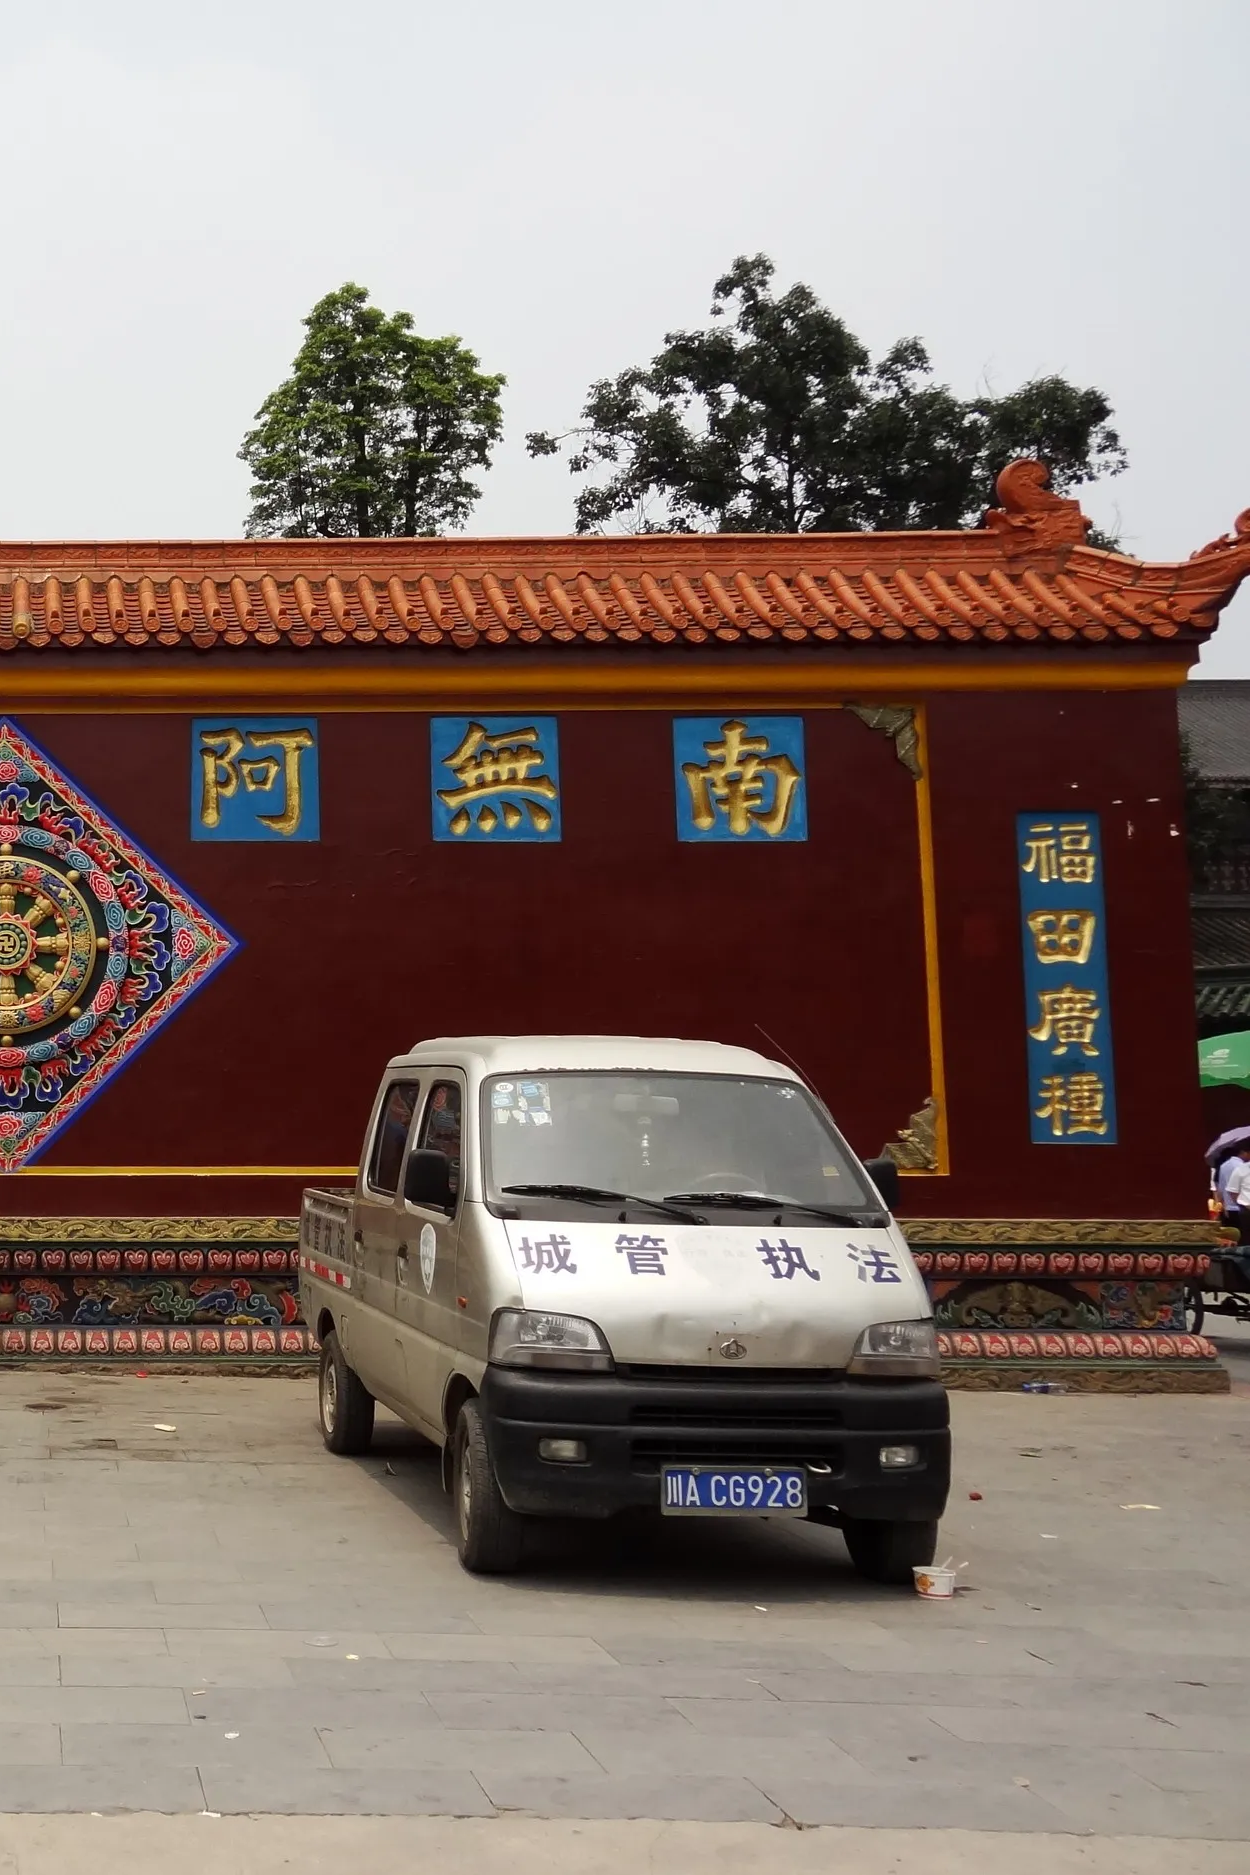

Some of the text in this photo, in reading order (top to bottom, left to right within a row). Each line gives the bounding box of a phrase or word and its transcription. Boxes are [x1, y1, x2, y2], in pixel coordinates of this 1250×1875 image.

[197, 726, 314, 836] 阿
[436, 721, 558, 835] 無
[682, 719, 802, 837] 南
